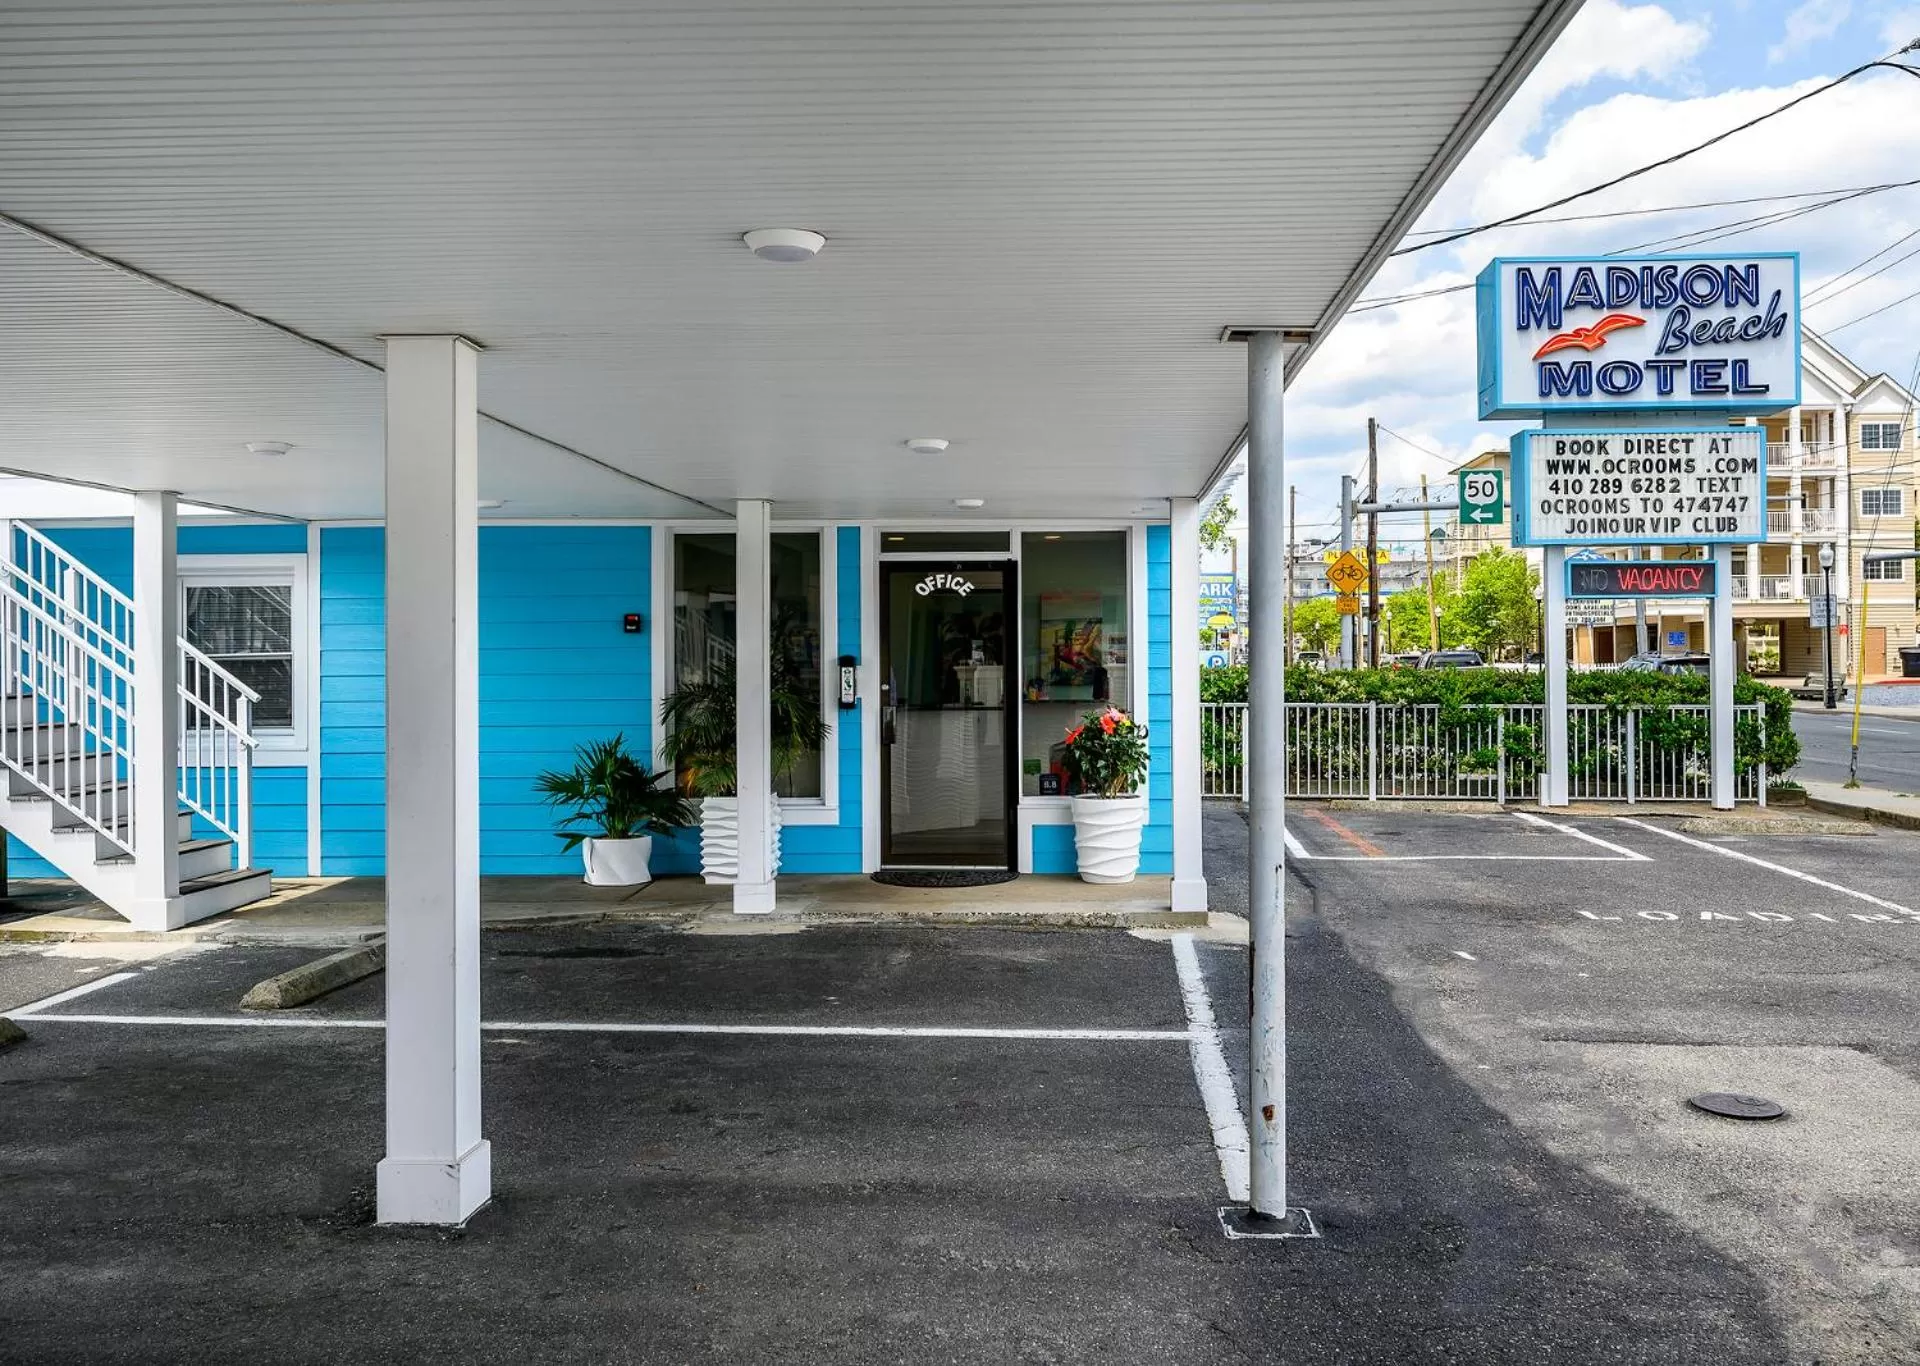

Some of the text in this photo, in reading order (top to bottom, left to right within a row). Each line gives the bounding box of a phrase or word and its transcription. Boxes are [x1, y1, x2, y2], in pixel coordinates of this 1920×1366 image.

[1516, 264, 1759, 330] MADISON
[1655, 289, 1788, 356] Beach
[1539, 359, 1770, 397] MOTEL
[1555, 437, 1733, 456] BOOK DIRECT AT
[1468, 480, 1495, 498] 50
[1549, 476, 1742, 495] 410 289 6282 TEXT
[1540, 496, 1749, 515] OCROOMS TO 474747
[1692, 516, 1738, 533] CLUB
[915, 574, 975, 597] OFFICE
[1580, 567, 1705, 592] NO VACANCY
[1577, 910, 1920, 923] LOADIN
